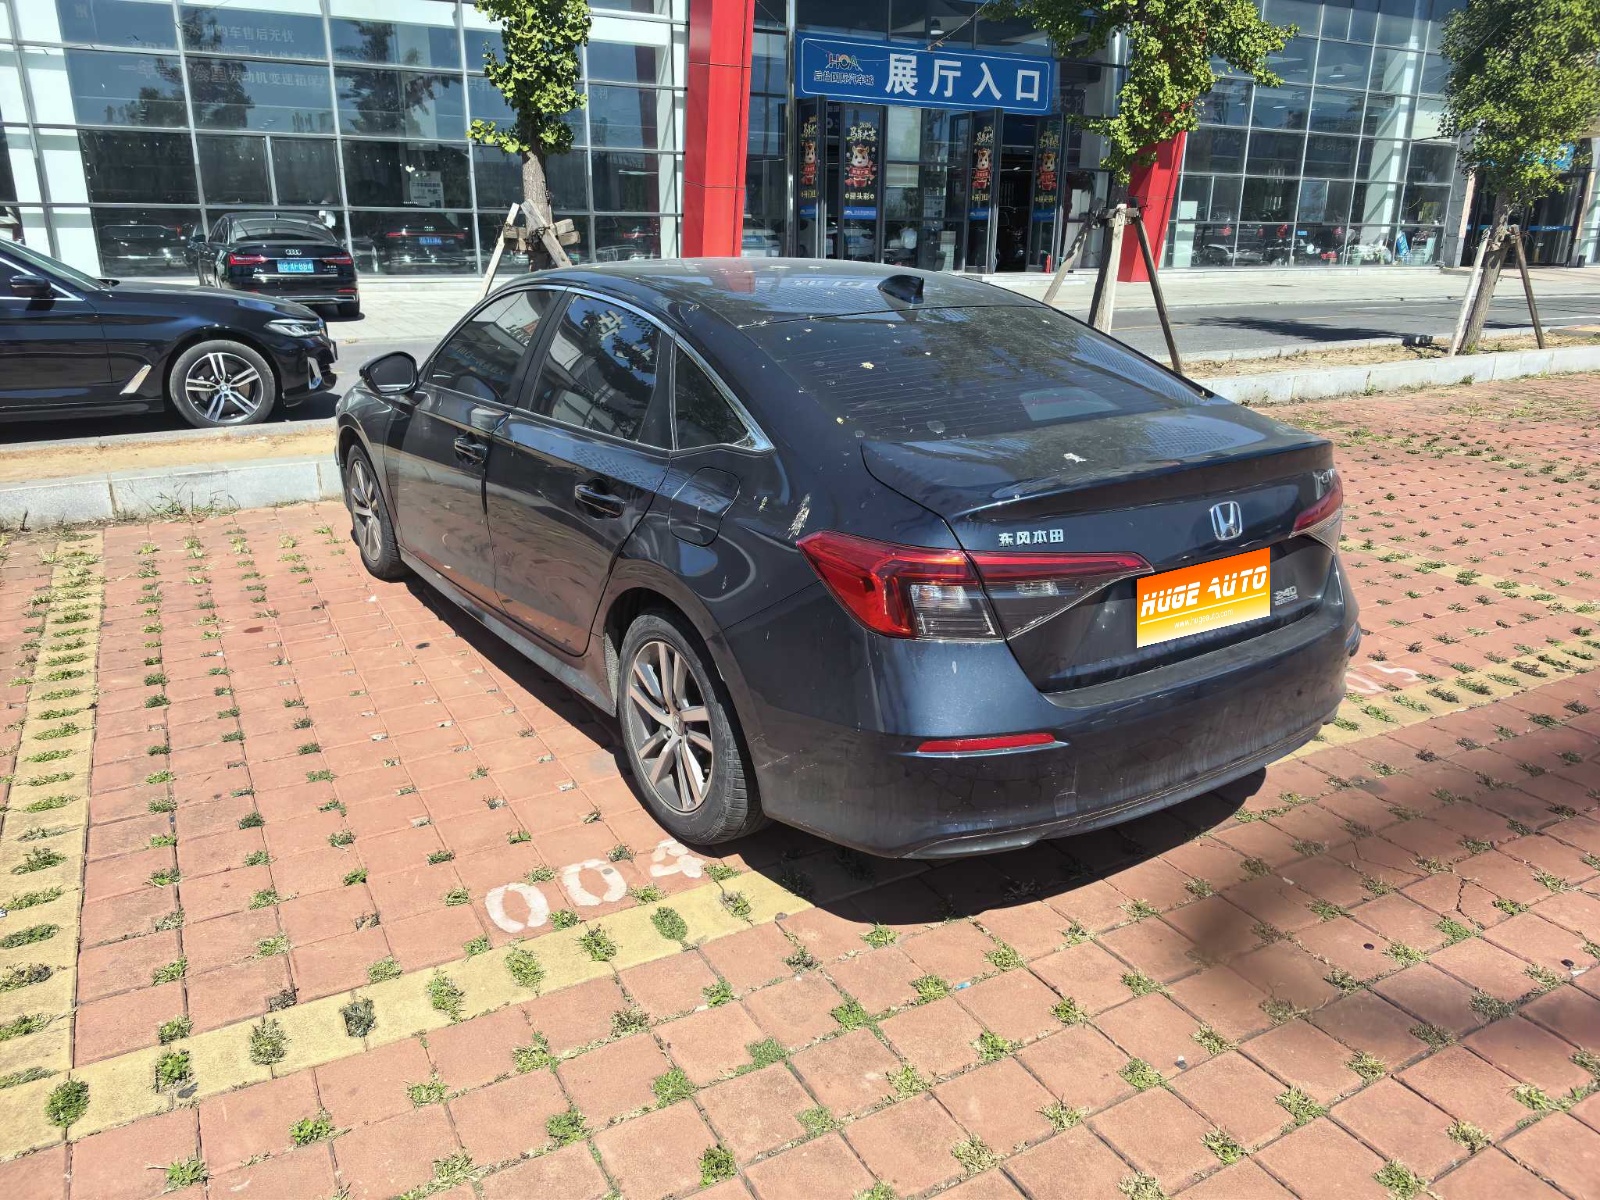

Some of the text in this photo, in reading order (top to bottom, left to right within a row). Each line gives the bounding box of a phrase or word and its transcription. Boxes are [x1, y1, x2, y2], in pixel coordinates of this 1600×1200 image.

[885, 53, 1040, 101] 展厅入口
[998, 529, 1064, 547] 东风本田
